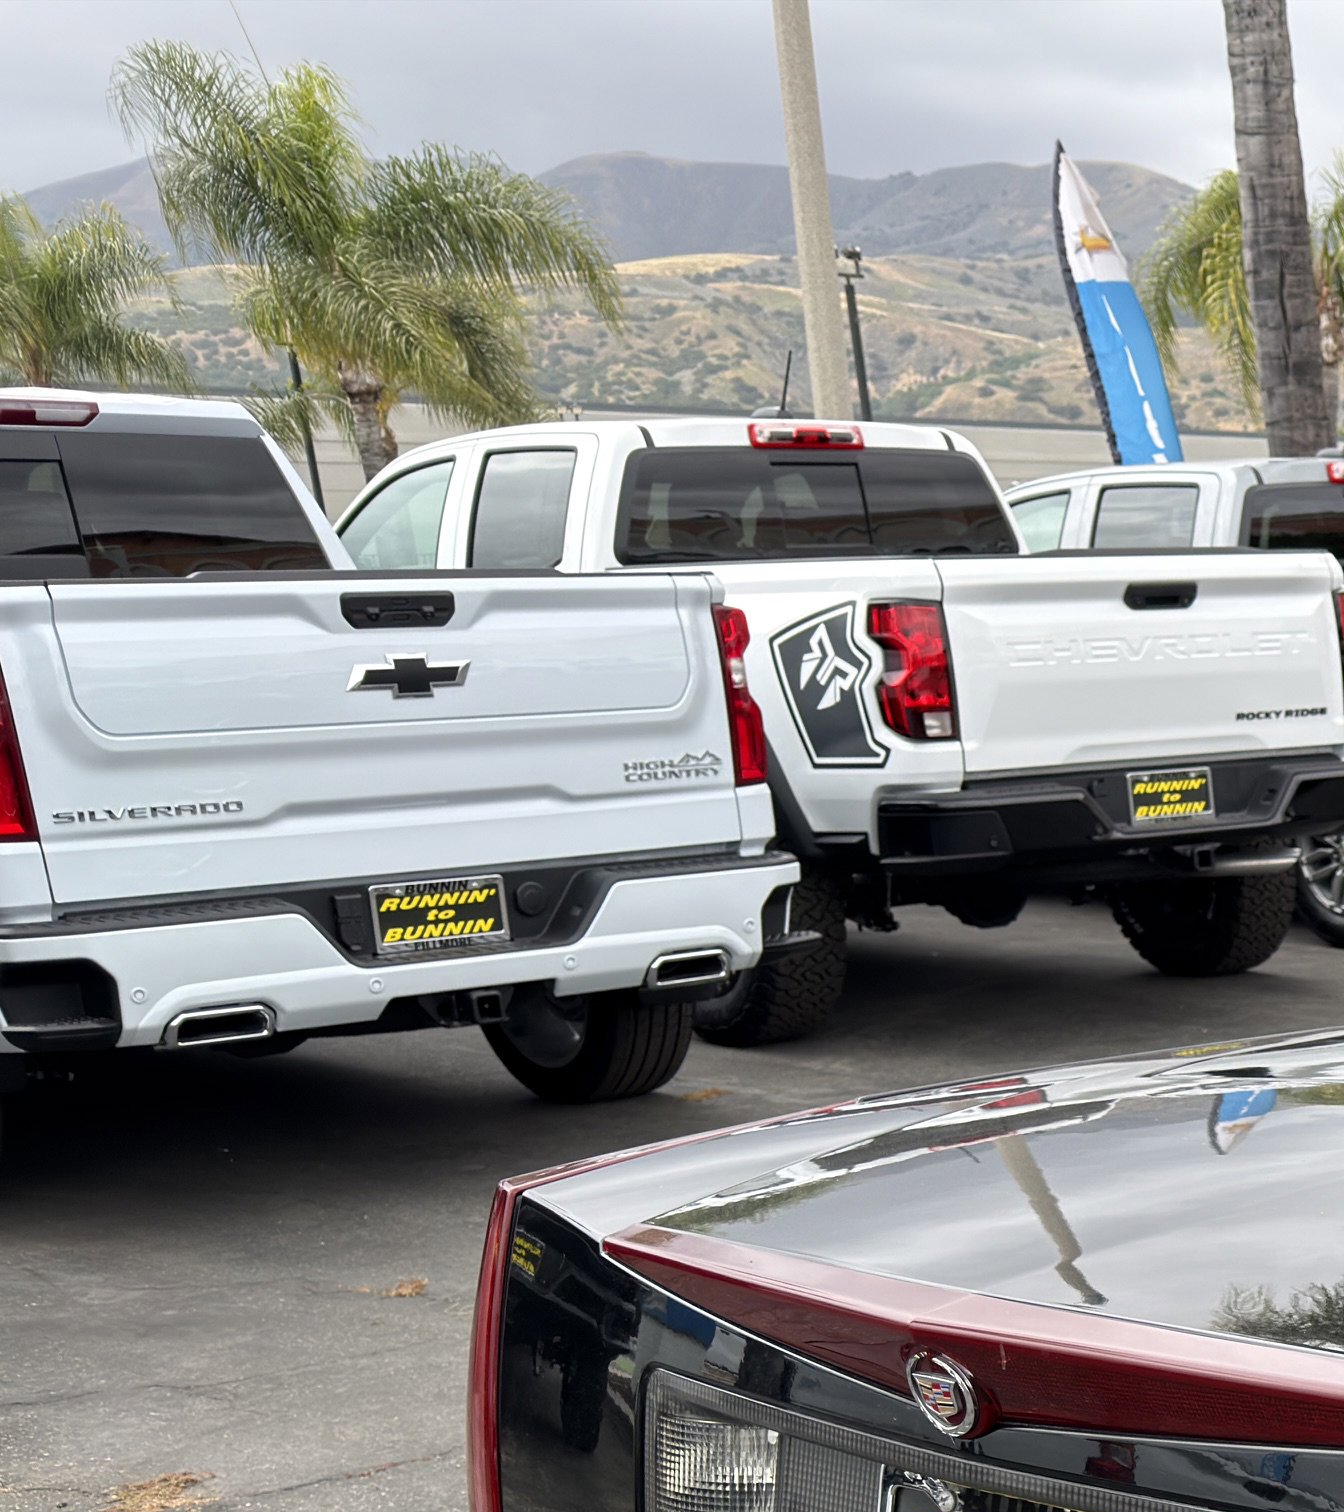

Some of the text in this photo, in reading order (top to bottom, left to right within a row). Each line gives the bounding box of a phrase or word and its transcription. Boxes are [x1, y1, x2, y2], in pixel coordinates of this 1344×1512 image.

[1006, 630, 1317, 668] CHEVROLET
[1236, 706, 1328, 722] ROCKY RIDGE
[623, 760, 674, 773] HIGH
[624, 767, 720, 783] COUNTRY
[1133, 777, 1207, 795] RUNNIN'
[1162, 792, 1182, 803] to
[52, 799, 245, 825] SILVERADO
[1135, 801, 1206, 820] BUNNIN
[404, 879, 470, 896] BUNNIN
[379, 888, 497, 913] RUNNIN'
[426, 909, 456, 921] to
[383, 917, 495, 943] BUNNIN
